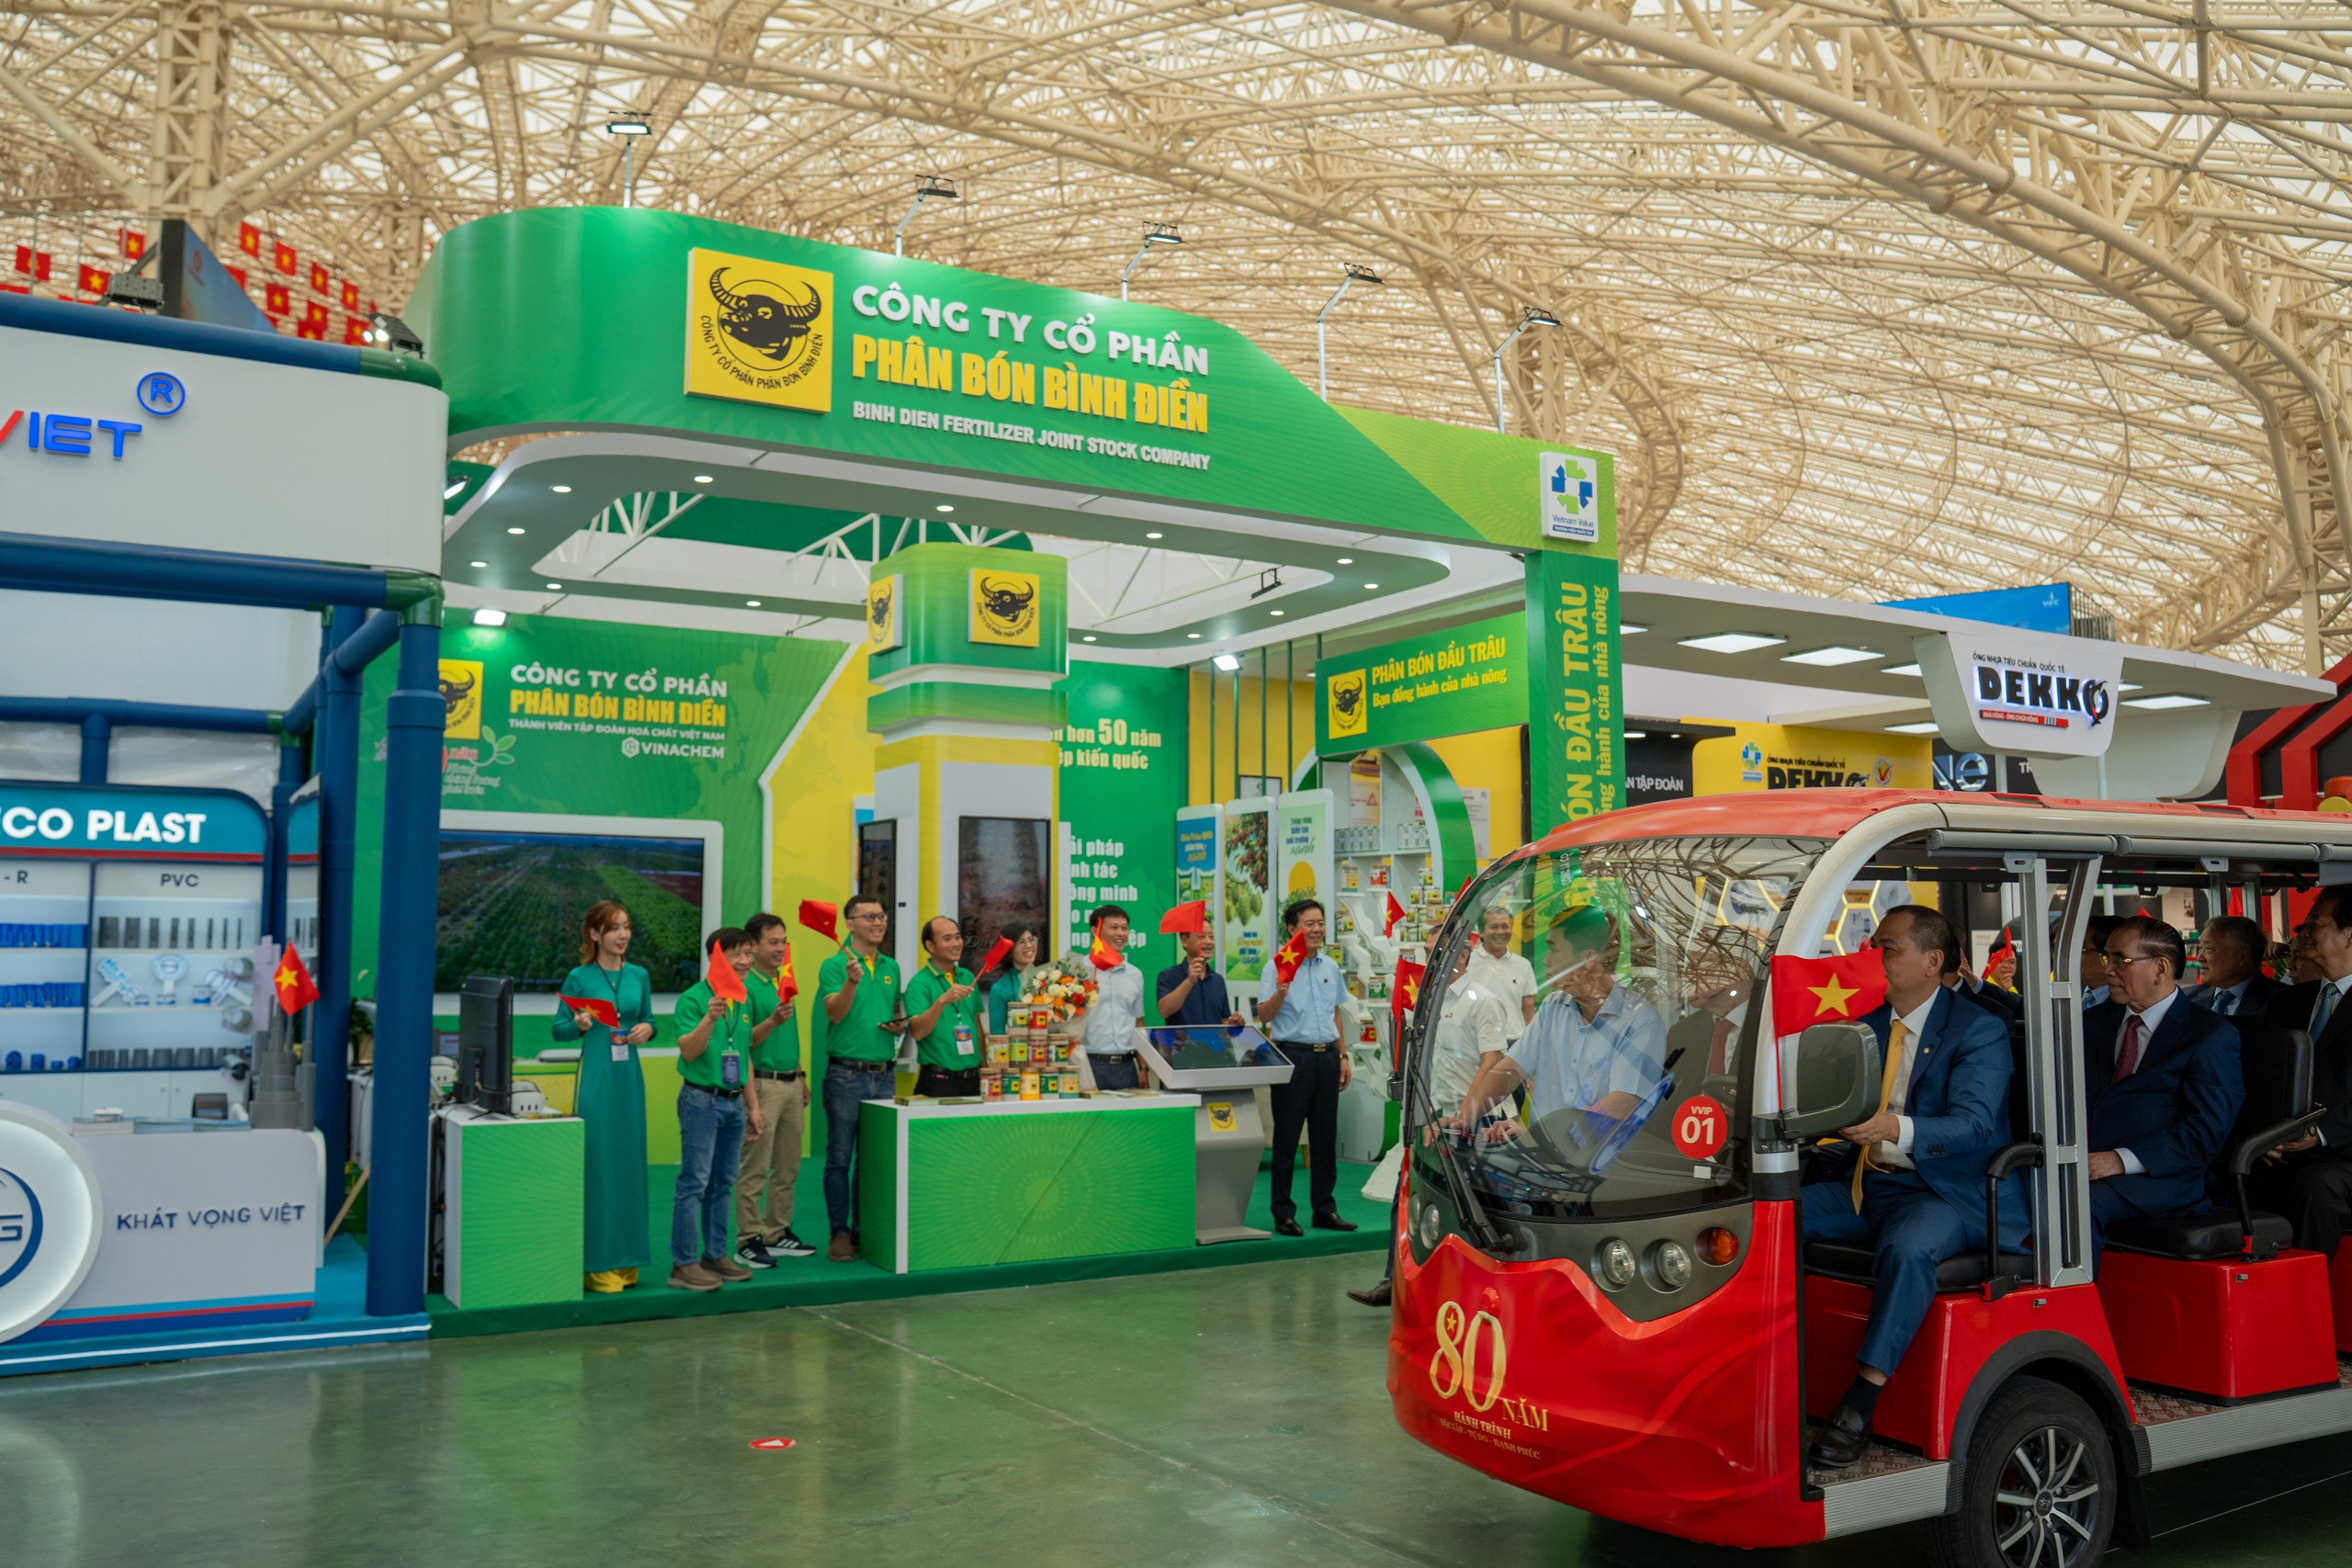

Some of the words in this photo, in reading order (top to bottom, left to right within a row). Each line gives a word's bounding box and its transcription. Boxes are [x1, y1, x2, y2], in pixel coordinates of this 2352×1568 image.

[852, 281, 970, 333] CÔNG
[981, 307, 1033, 343] TY
[1043, 312, 1097, 354] CỔ
[1107, 330, 1209, 376] PHẦN
[852, 333, 952, 391] PHÂN
[961, 350, 1035, 405] BÓN
[1043, 361, 1127, 420] BÌNH
[1133, 378, 1208, 434] ĐIỀN
[853, 400, 895, 423] BINH
[899, 408, 939, 430] DIEN
[943, 414, 1035, 444] FERTILIZER
[1037, 429, 1084, 452] JOINT
[1087, 437, 1137, 460] STOCK
[1140, 445, 1211, 470] COMPANY
[1552, 514, 1577, 525] Vietnam
[1577, 518, 1594, 528] Value
[1555, 581, 1589, 676] TRÂU
[1591, 585, 1609, 636] nông
[1372, 658, 1405, 685] PHÂN
[1408, 651, 1434, 678] BÓN
[1437, 640, 1464, 671] ĐẦU
[1468, 634, 1506, 663] TRÂU
[1592, 640, 1609, 678] nhà
[511, 660, 581, 686] CÔNG
[587, 670, 618, 689] TY
[624, 667, 658, 693] CỔ
[663, 672, 728, 697] PHẦN
[1373, 693, 1390, 709] Bạn
[1392, 685, 1415, 703] đồng
[1417, 681, 1439, 698] hành
[1441, 675, 1458, 694] của
[1461, 672, 1479, 689] nhà
[1481, 668, 1507, 684] nông
[1977, 666, 2109, 722] DEKKO
[510, 687, 570, 716] PHÂN
[574, 692, 619, 720] BÓN
[623, 694, 675, 724] BÌNH
[678, 698, 726, 727] ĐIỀN
[1592, 684, 1610, 721] của
[1067, 725, 1095, 744] hơn
[1098, 717, 1127, 746] 50
[1131, 728, 1161, 748] năm
[1554, 688, 1592, 762] ĐẦU
[641, 741, 726, 759] VINACHEM
[1077, 747, 1109, 768] kiến
[1113, 750, 1148, 770] quốc
[1595, 728, 1612, 776] hành
[1560, 773, 1594, 821] ÓN
[1595, 783, 1615, 814] ng
[1635, 774, 1655, 792] TẬP
[1655, 776, 1684, 792] ĐOÀN
[0, 807, 74, 840] CO
[86, 809, 207, 843] PLAST
[1086, 839, 1124, 858] pháp
[160, 874, 199, 887] PVC
[1093, 861, 1118, 879] tác
[1070, 883, 1096, 903] ông
[1100, 885, 1138, 901] minh
[1690, 1106, 1713, 1115] VVIP
[1680, 1115, 1715, 1145] 01
[117, 1207, 178, 1230] KHÁT
[187, 1207, 252, 1228] VỌNG
[260, 1201, 306, 1224] VIỆT
[1430, 1301, 1508, 1412] 80
[1453, 1411, 1479, 1429] HÀNH
[1480, 1420, 1512, 1440] TRÌNH
[1502, 1397, 1549, 1432] NĂM
